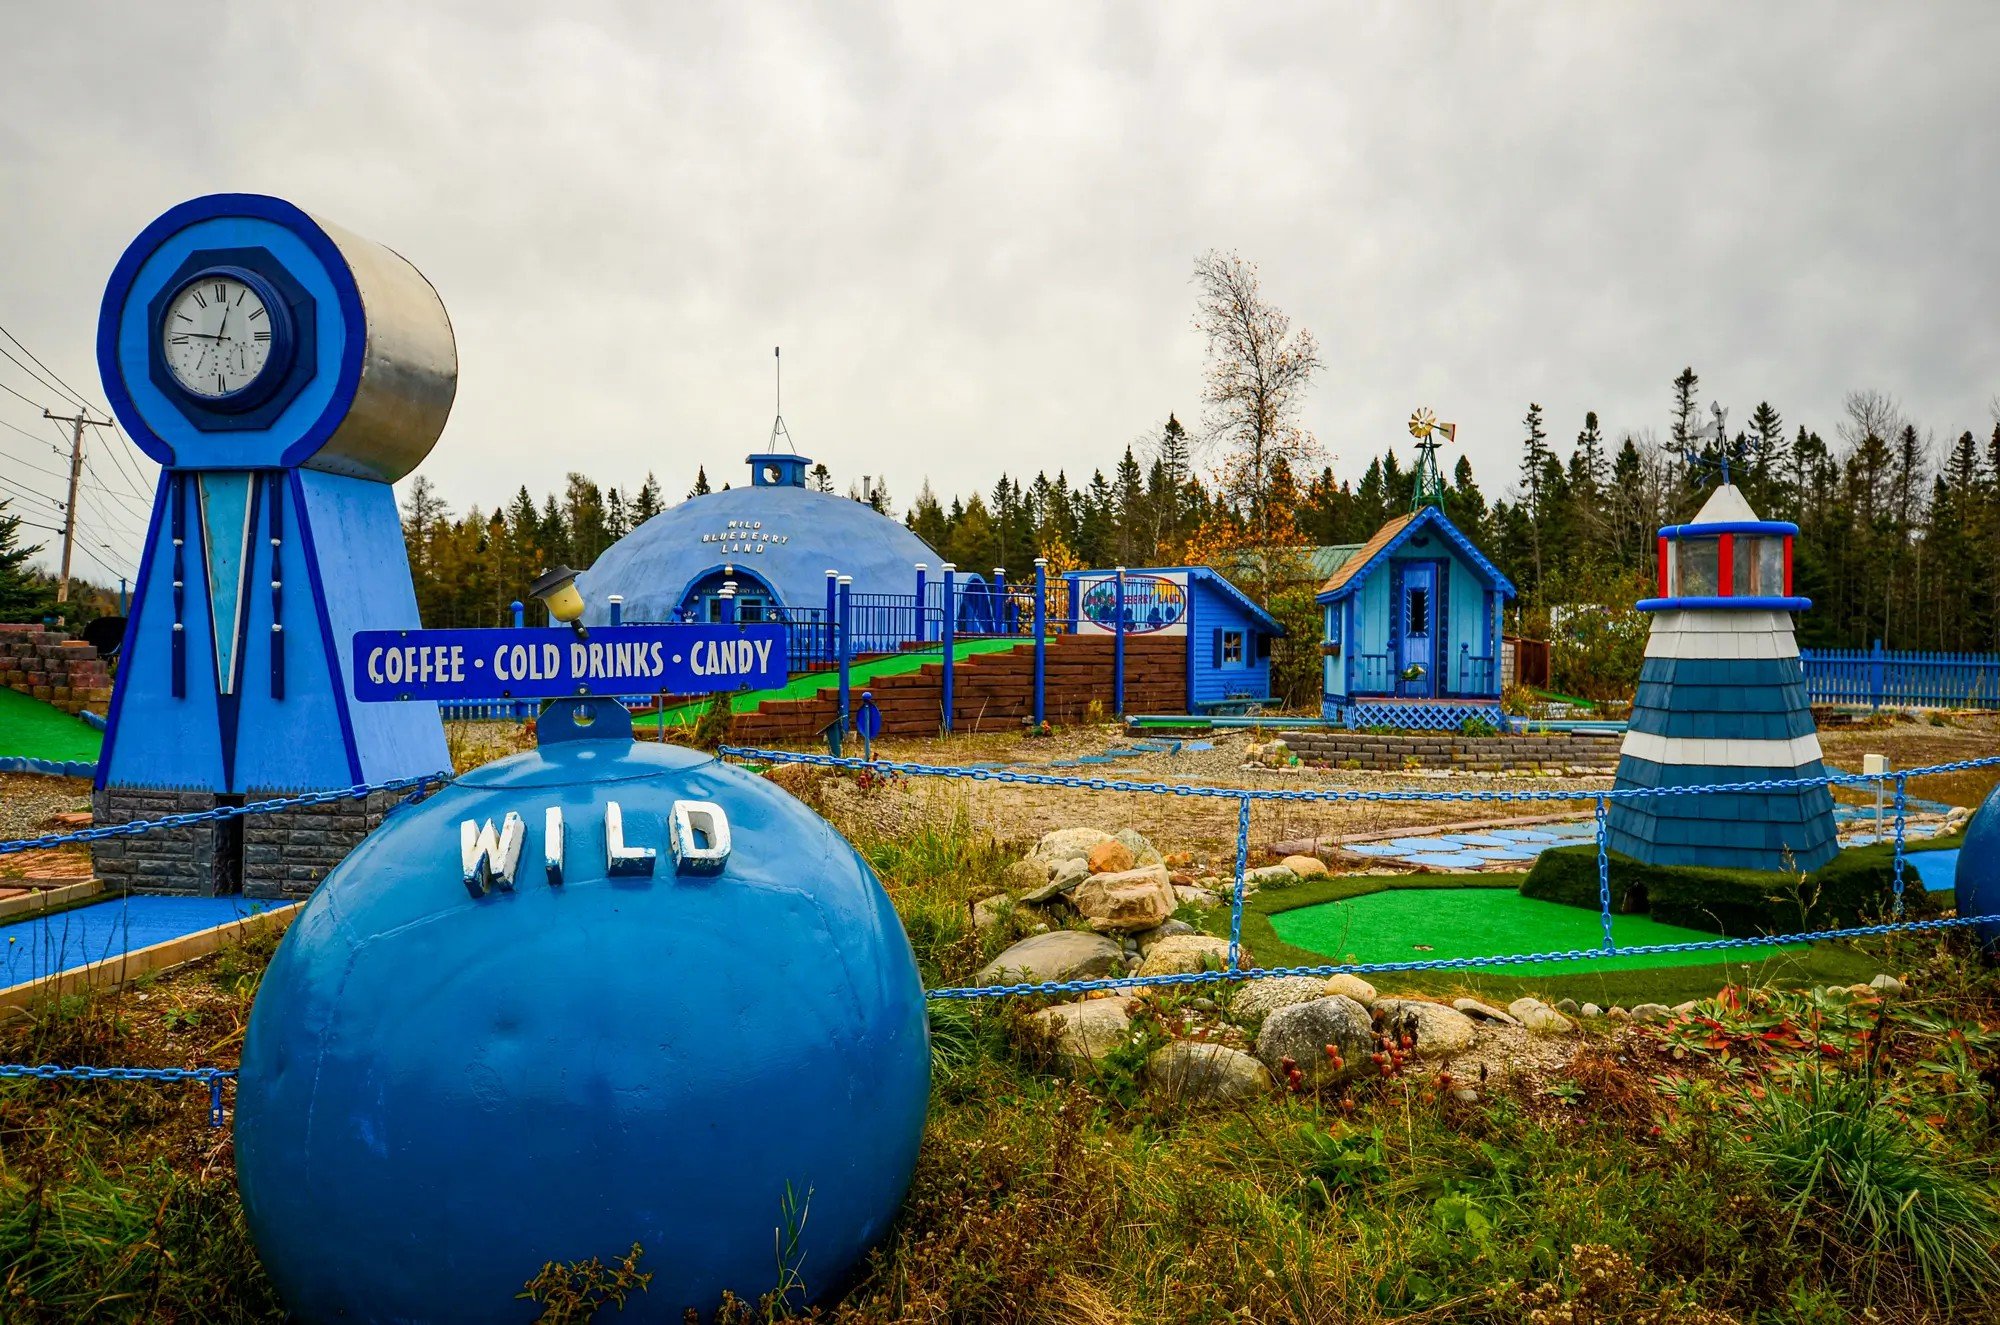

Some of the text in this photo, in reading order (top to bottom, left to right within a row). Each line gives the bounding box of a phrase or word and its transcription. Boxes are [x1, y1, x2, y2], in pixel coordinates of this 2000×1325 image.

[727, 520, 761, 529] WILD
[702, 531, 788, 545] BLUEBERRY
[721, 543, 764, 554] LAND
[367, 639, 773, 684] COFFEE COLD DRINKS CANDY
[460, 800, 732, 898] WILD
